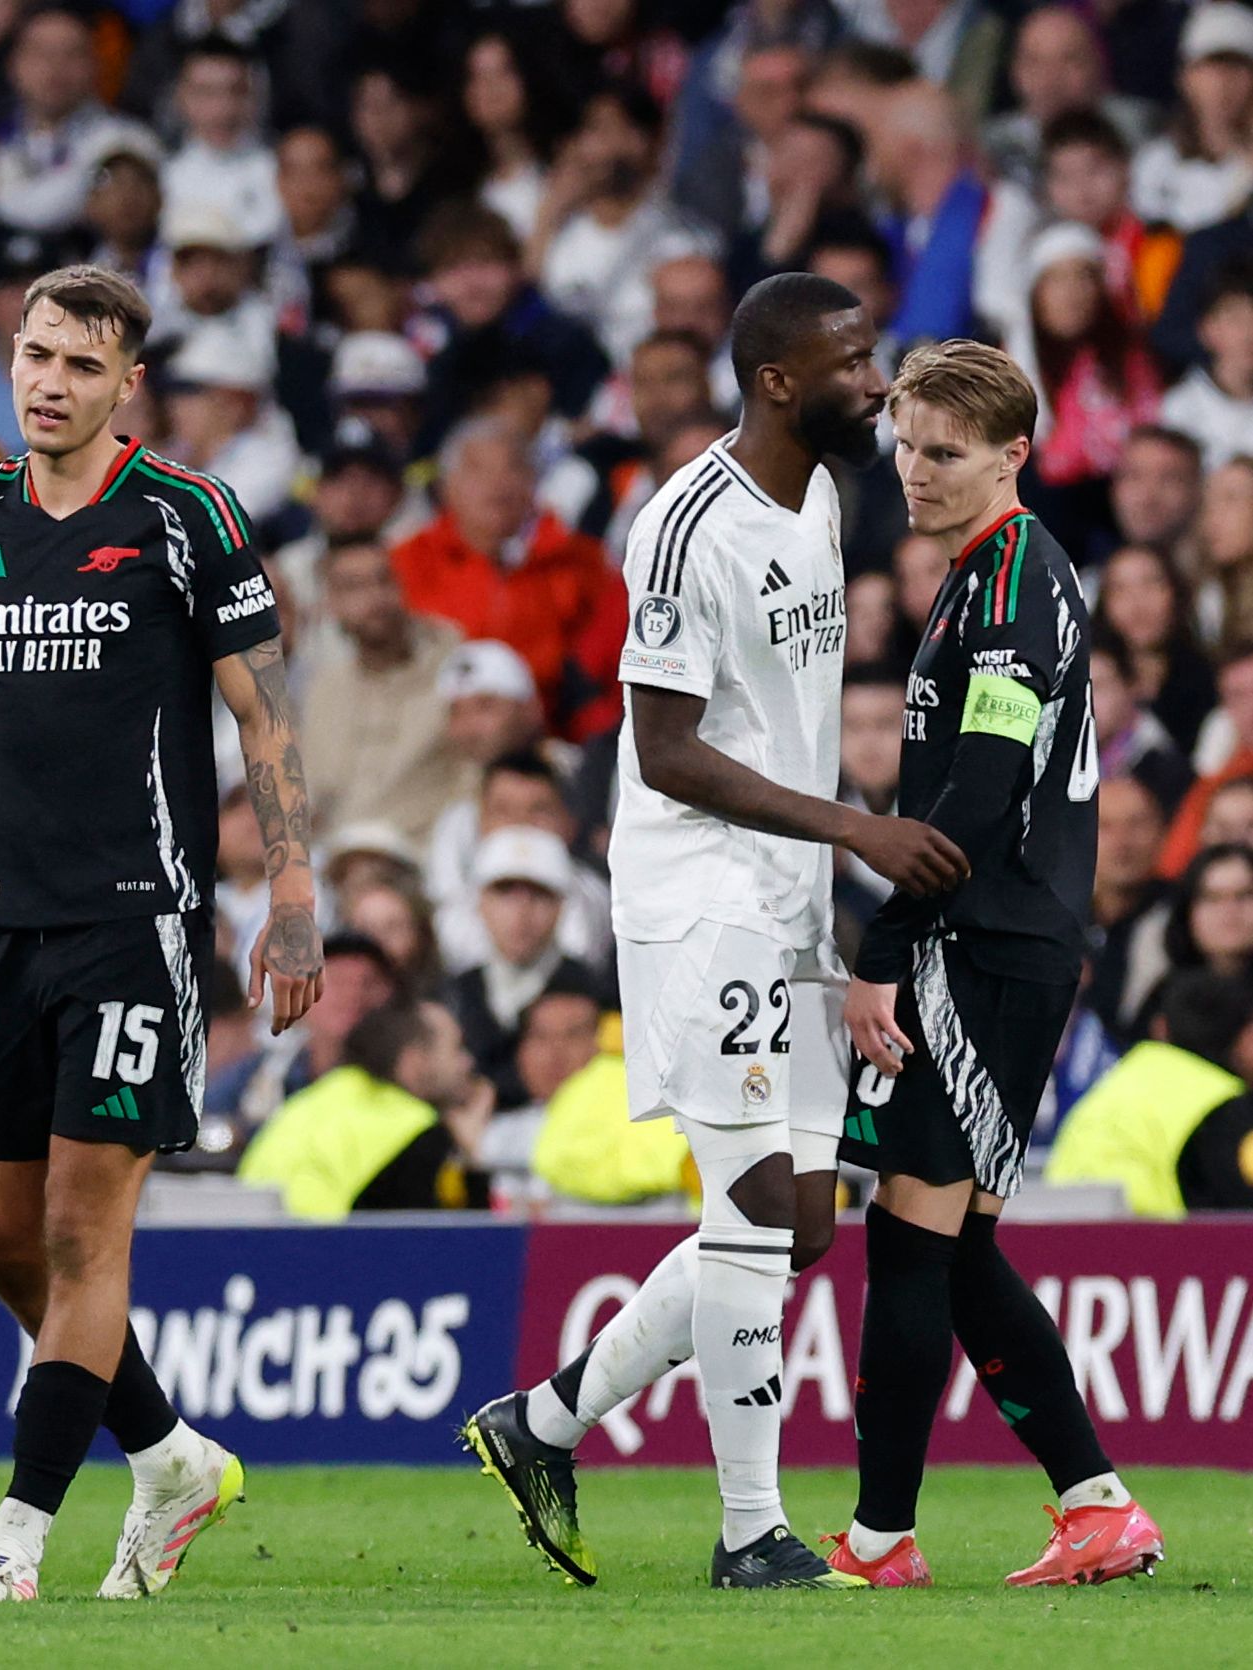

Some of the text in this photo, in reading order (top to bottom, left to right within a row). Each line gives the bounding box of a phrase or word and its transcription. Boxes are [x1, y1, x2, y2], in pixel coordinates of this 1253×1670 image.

[647, 620, 663, 633] 15
[22, 638, 102, 672] BETTER
[972, 649, 1016, 665] VISIT
[989, 698, 1037, 719] RESPECT
[91, 1000, 166, 1085] 15
[731, 1324, 782, 1347] RMC
